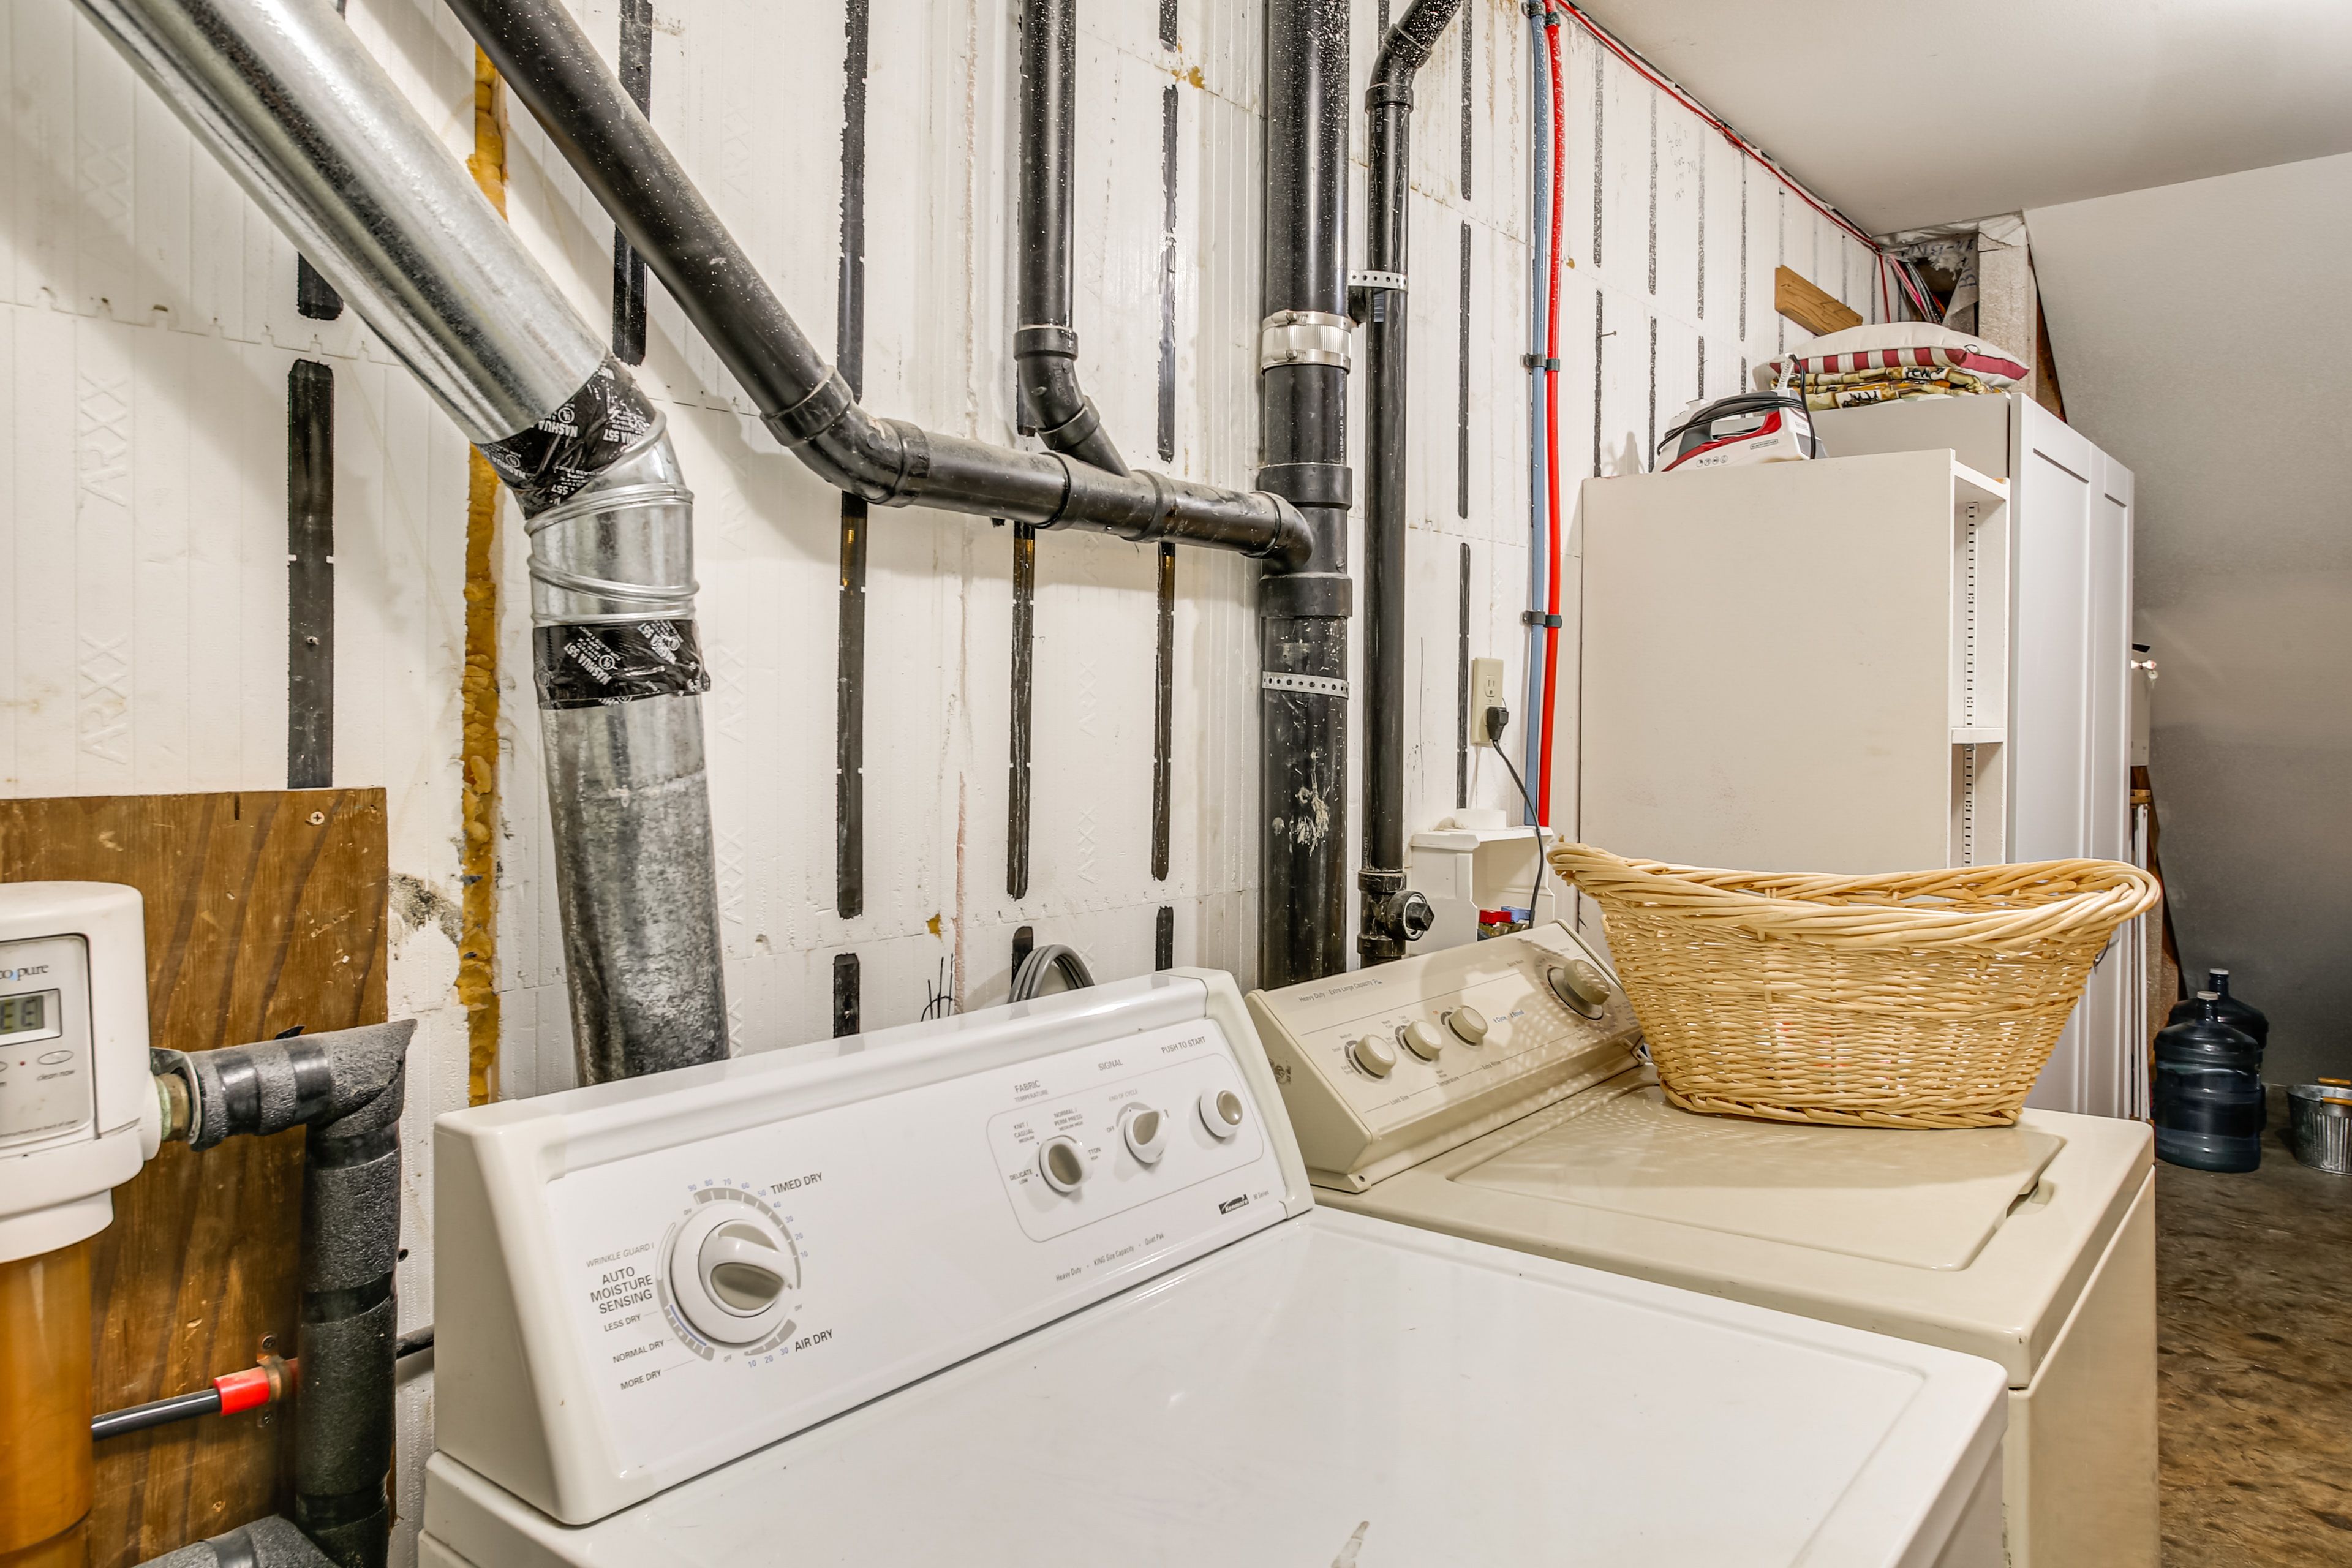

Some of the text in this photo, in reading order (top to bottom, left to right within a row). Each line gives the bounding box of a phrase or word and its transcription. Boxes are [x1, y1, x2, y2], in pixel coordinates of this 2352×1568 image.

[538, 420, 578, 437] NASHUA
[602, 429, 619, 442] 557
[80, 371, 127, 507] ARXX
[492, 456, 526, 479] NASHUA
[551, 484, 568, 496] 557
[637, 622, 655, 639] 557
[563, 641, 581, 660] 557
[576, 652, 612, 686] NASHUA
[80, 633, 127, 765] ARXX
[1354, 980, 1373, 989] Capacity
[1161, 1043, 1178, 1054] PUSH
[1188, 1036, 1206, 1047] START
[1098, 1058, 1123, 1071] SIGNAL
[37, 1072, 58, 1082] clean
[1014, 1080, 1040, 1093] FABRIC
[1125, 1088, 1138, 1097] CYCLE
[1014, 1089, 1049, 1103] TEMPERATURE
[1054, 1109, 1074, 1118] NORMAL
[1054, 1114, 1083, 1126] PERM PRESS
[1014, 1128, 1035, 1139] CASUAL
[1088, 1147, 1101, 1155] TTON
[1009, 1168, 1033, 1181] DELICATE
[741, 1182, 750, 1190] 60
[771, 1172, 824, 1194] TIMED DRY
[1225, 1199, 1248, 1212] Kenmore
[586, 1251, 621, 1267] WRINKLE
[623, 1243, 650, 1257] GUARD
[1056, 1272, 1071, 1282] Heavy
[1071, 1267, 1082, 1276] Duty
[1093, 1256, 1106, 1266] KING
[1106, 1253, 1115, 1262] Size
[1115, 1245, 1134, 1257] Capacity
[1144, 1236, 1156, 1246] Quiet
[602, 1266, 635, 1285] AUTO
[590, 1274, 653, 1303] MOISTURE
[599, 1289, 653, 1314] SENSING
[603, 1313, 641, 1332] LESS DRY
[795, 1328, 833, 1352] AIR DRY
[612, 1339, 665, 1363] NORMAL DRY
[780, 1347, 789, 1356] 30
[723, 1354, 732, 1363] OFF
[748, 1359, 757, 1368] 10
[764, 1355, 774, 1364] 20
[620, 1369, 662, 1390] MORE DRY
